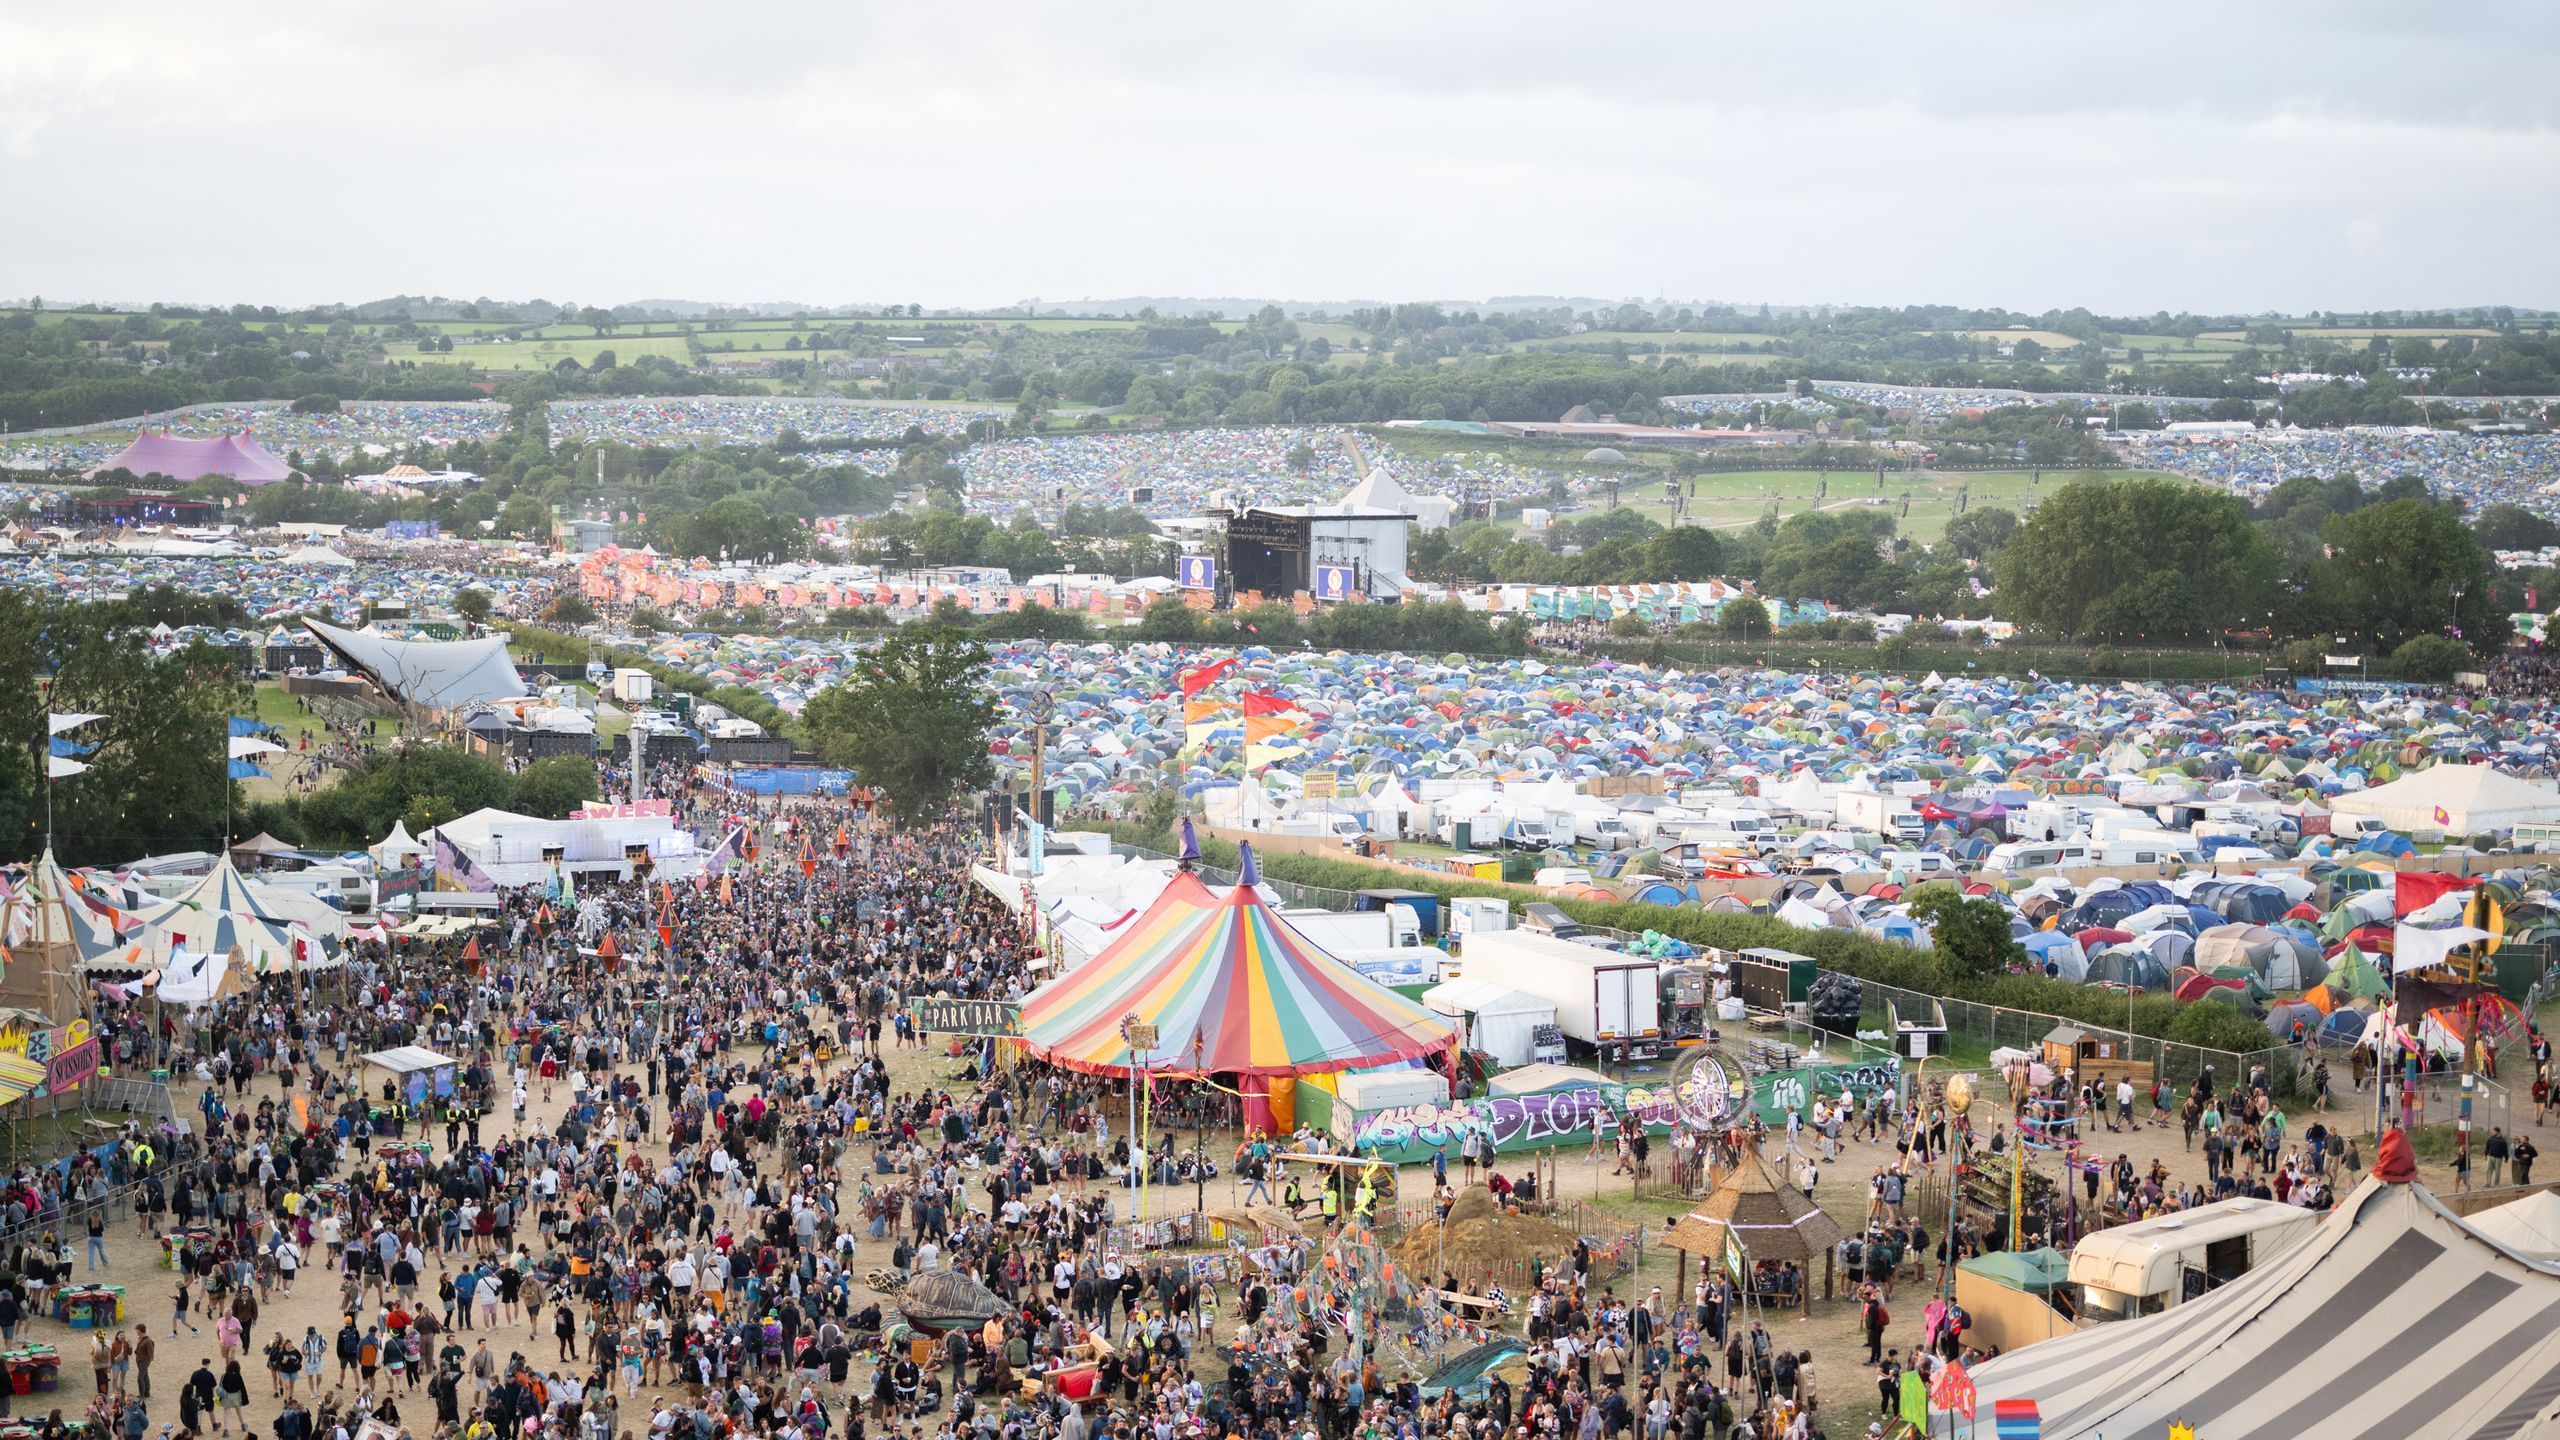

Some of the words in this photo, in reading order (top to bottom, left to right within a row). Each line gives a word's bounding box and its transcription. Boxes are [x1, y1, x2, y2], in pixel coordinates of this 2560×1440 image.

[2544, 746, 2553, 776] CASH
[933, 1006, 968, 1028] PARK
[975, 1004, 1003, 1026] BAR
[55, 1046, 94, 1084] SCISSORS
